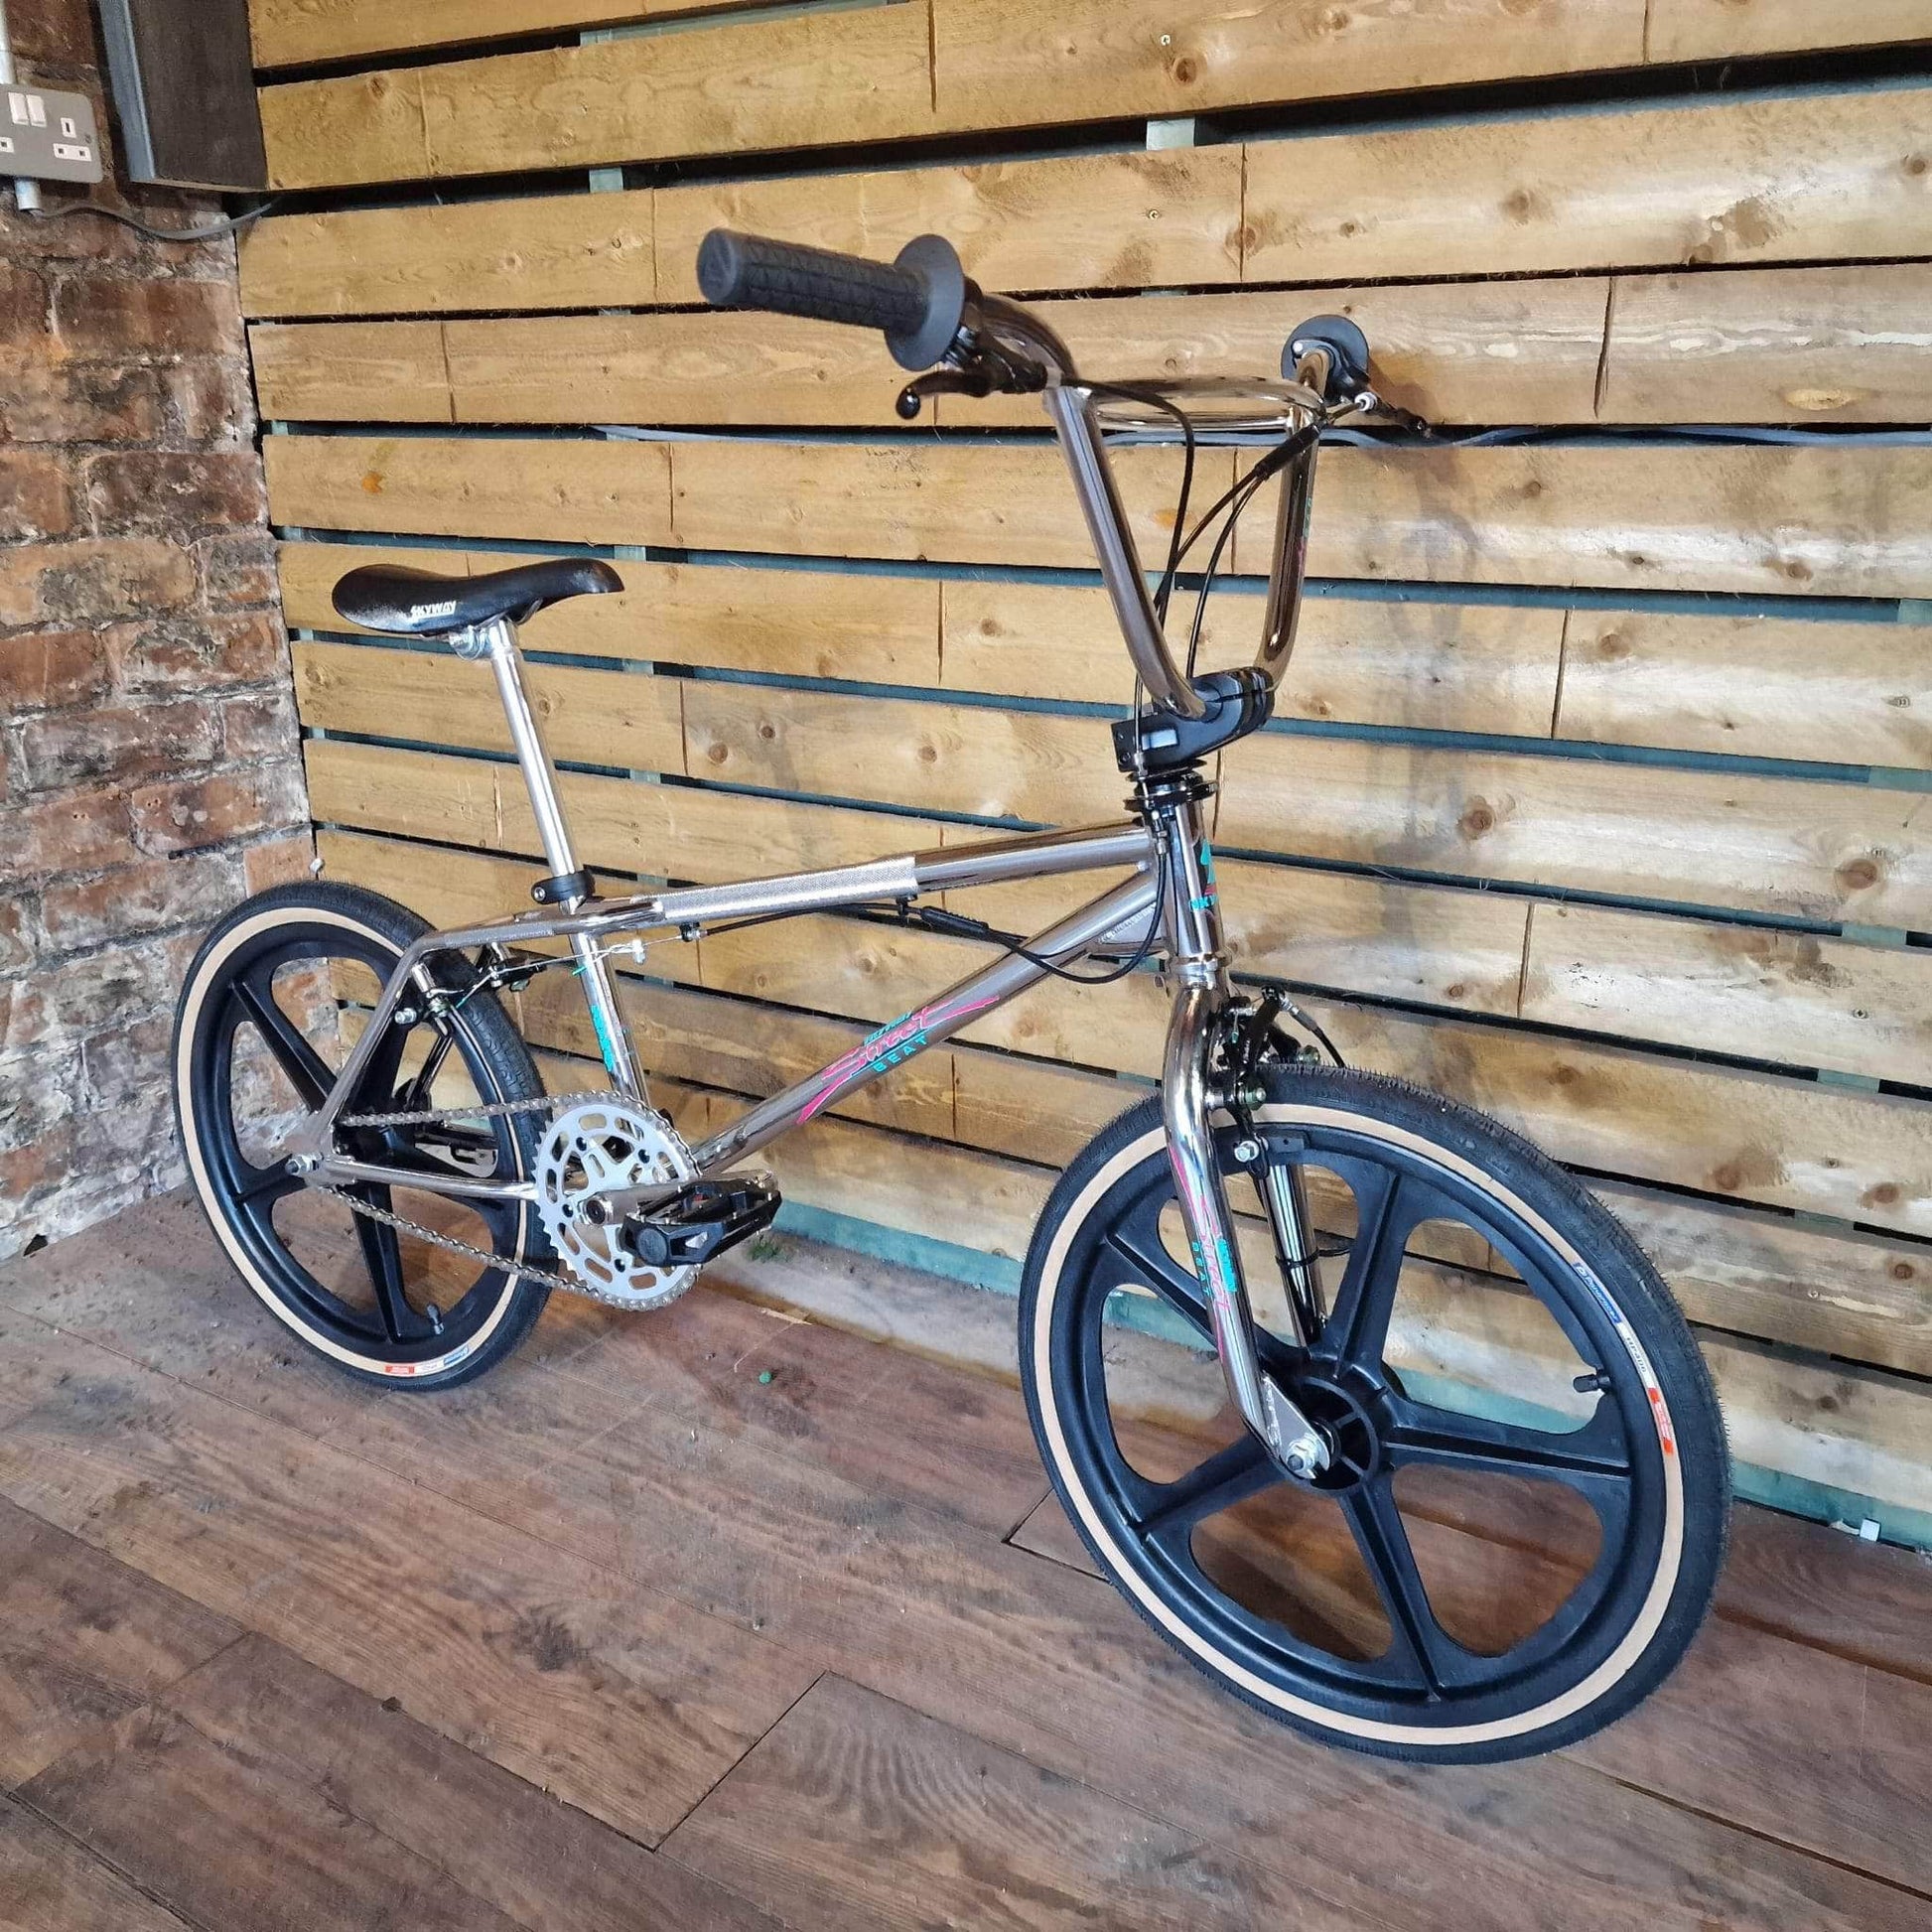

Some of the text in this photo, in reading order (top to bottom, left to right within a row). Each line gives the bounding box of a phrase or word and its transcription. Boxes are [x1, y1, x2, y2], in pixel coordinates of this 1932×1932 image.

[410, 600, 457, 619] SKYWAY
[872, 1035, 928, 1073] BEAT
[1191, 1241, 1213, 1299] BEAT
